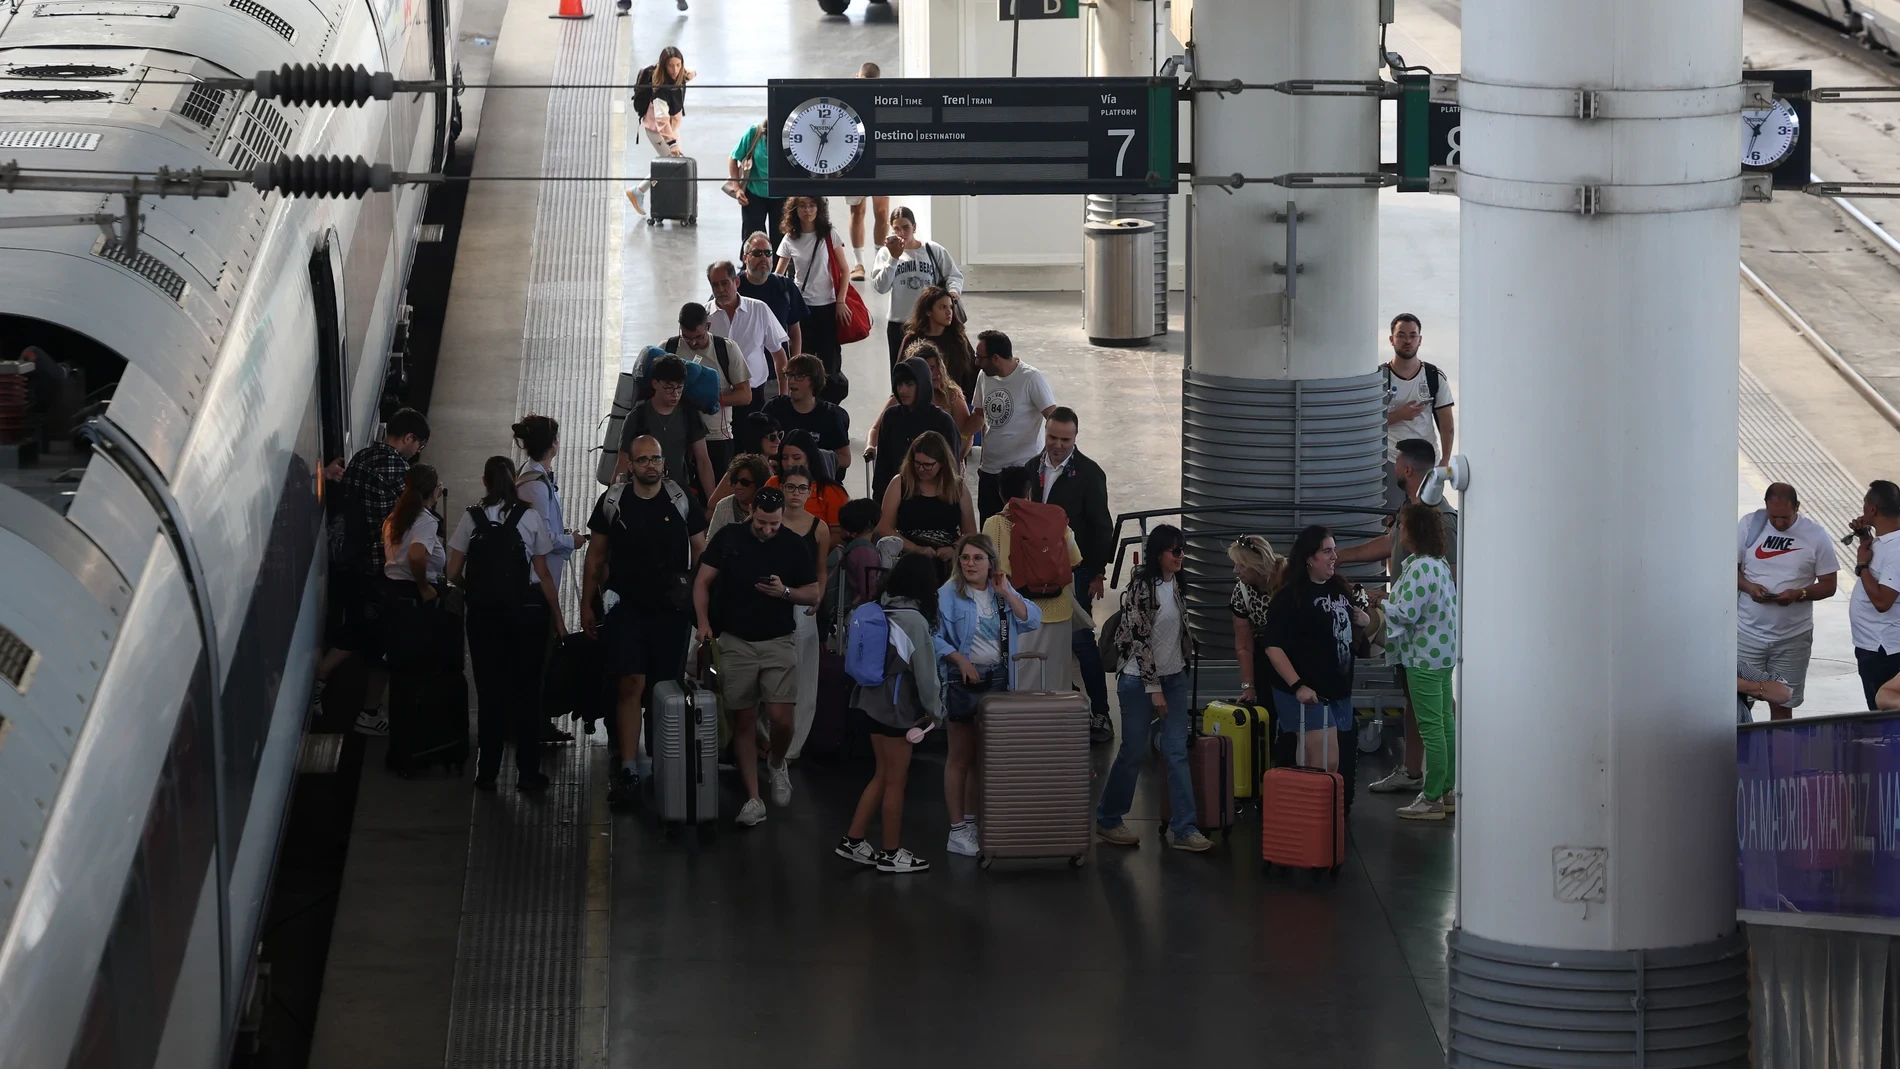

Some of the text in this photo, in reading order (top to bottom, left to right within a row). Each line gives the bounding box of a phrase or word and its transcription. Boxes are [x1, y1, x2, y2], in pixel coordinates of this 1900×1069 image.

[874, 95, 899, 105] Hora
[942, 95, 993, 105] Tren TRAIN
[1101, 94, 1117, 104] Vía
[817, 109, 831, 119] 12
[874, 130, 965, 141] Destino DESTINATION
[1778, 126, 1787, 135] 3
[794, 134, 803, 143] 9
[845, 134, 854, 143] 3
[1107, 129, 1136, 177] 7
[1751, 151, 1760, 160] 6
[819, 160, 828, 169] 6
[991, 403, 1002, 413] 84
[1762, 535, 1795, 551] NIKE
[1760, 776, 1814, 865] MADRID,
